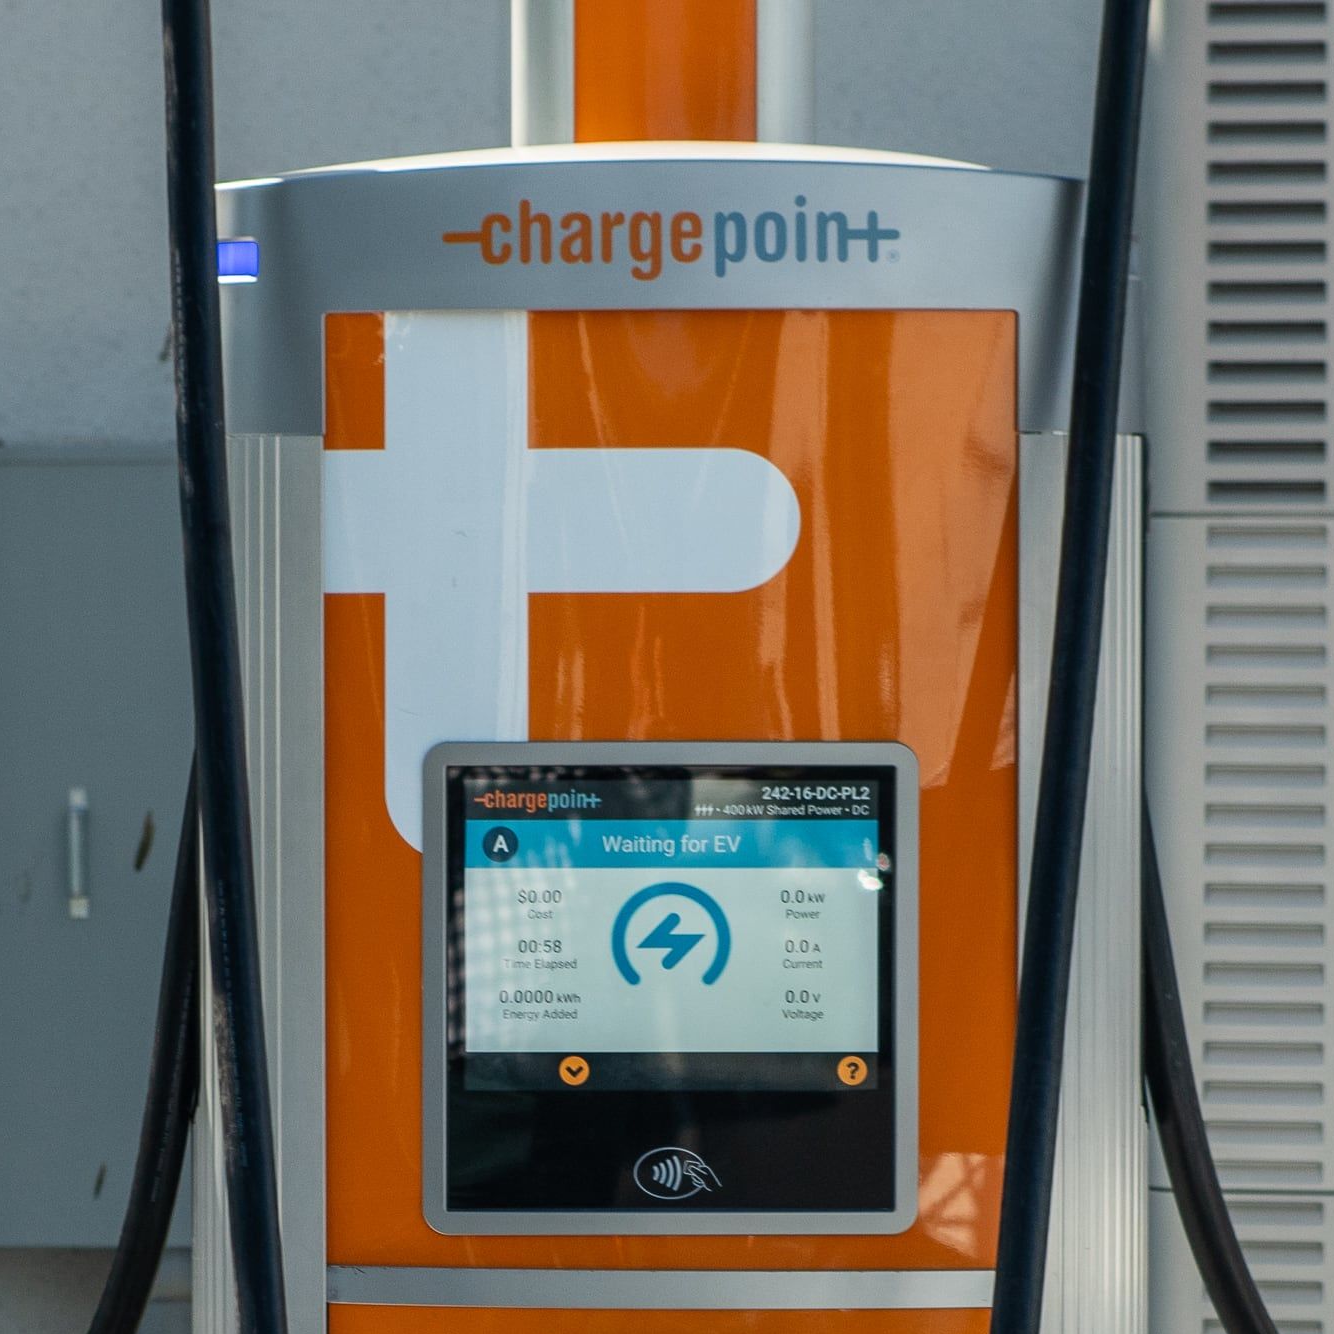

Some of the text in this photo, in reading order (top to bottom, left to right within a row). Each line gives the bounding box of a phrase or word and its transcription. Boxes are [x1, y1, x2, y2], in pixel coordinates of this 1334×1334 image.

[442, 194, 900, 281] chargepoint
[761, 786, 871, 800] 242-16-DC-PL2
[474, 789, 602, 813] chargepoint
[766, 804, 806, 816] Shared
[808, 804, 843, 816] Power
[851, 804, 870, 816] DC
[492, 834, 510, 853] A
[601, 834, 742, 856] Waiting for EV
[517, 888, 563, 904] $0.00
[780, 889, 826, 904] 0.0 kW
[527, 908, 554, 920] Cost
[785, 908, 821, 920] Power
[517, 939, 563, 954] 00:58
[784, 939, 809, 954] 0.0
[503, 958, 578, 971] Time Elapsed
[782, 958, 824, 970] Current
[499, 989, 582, 1004] 0.0000 kWh
[784, 989, 810, 1004] 0.0
[502, 1008, 579, 1022] Energy Added
[781, 1008, 825, 1022] Voltage
